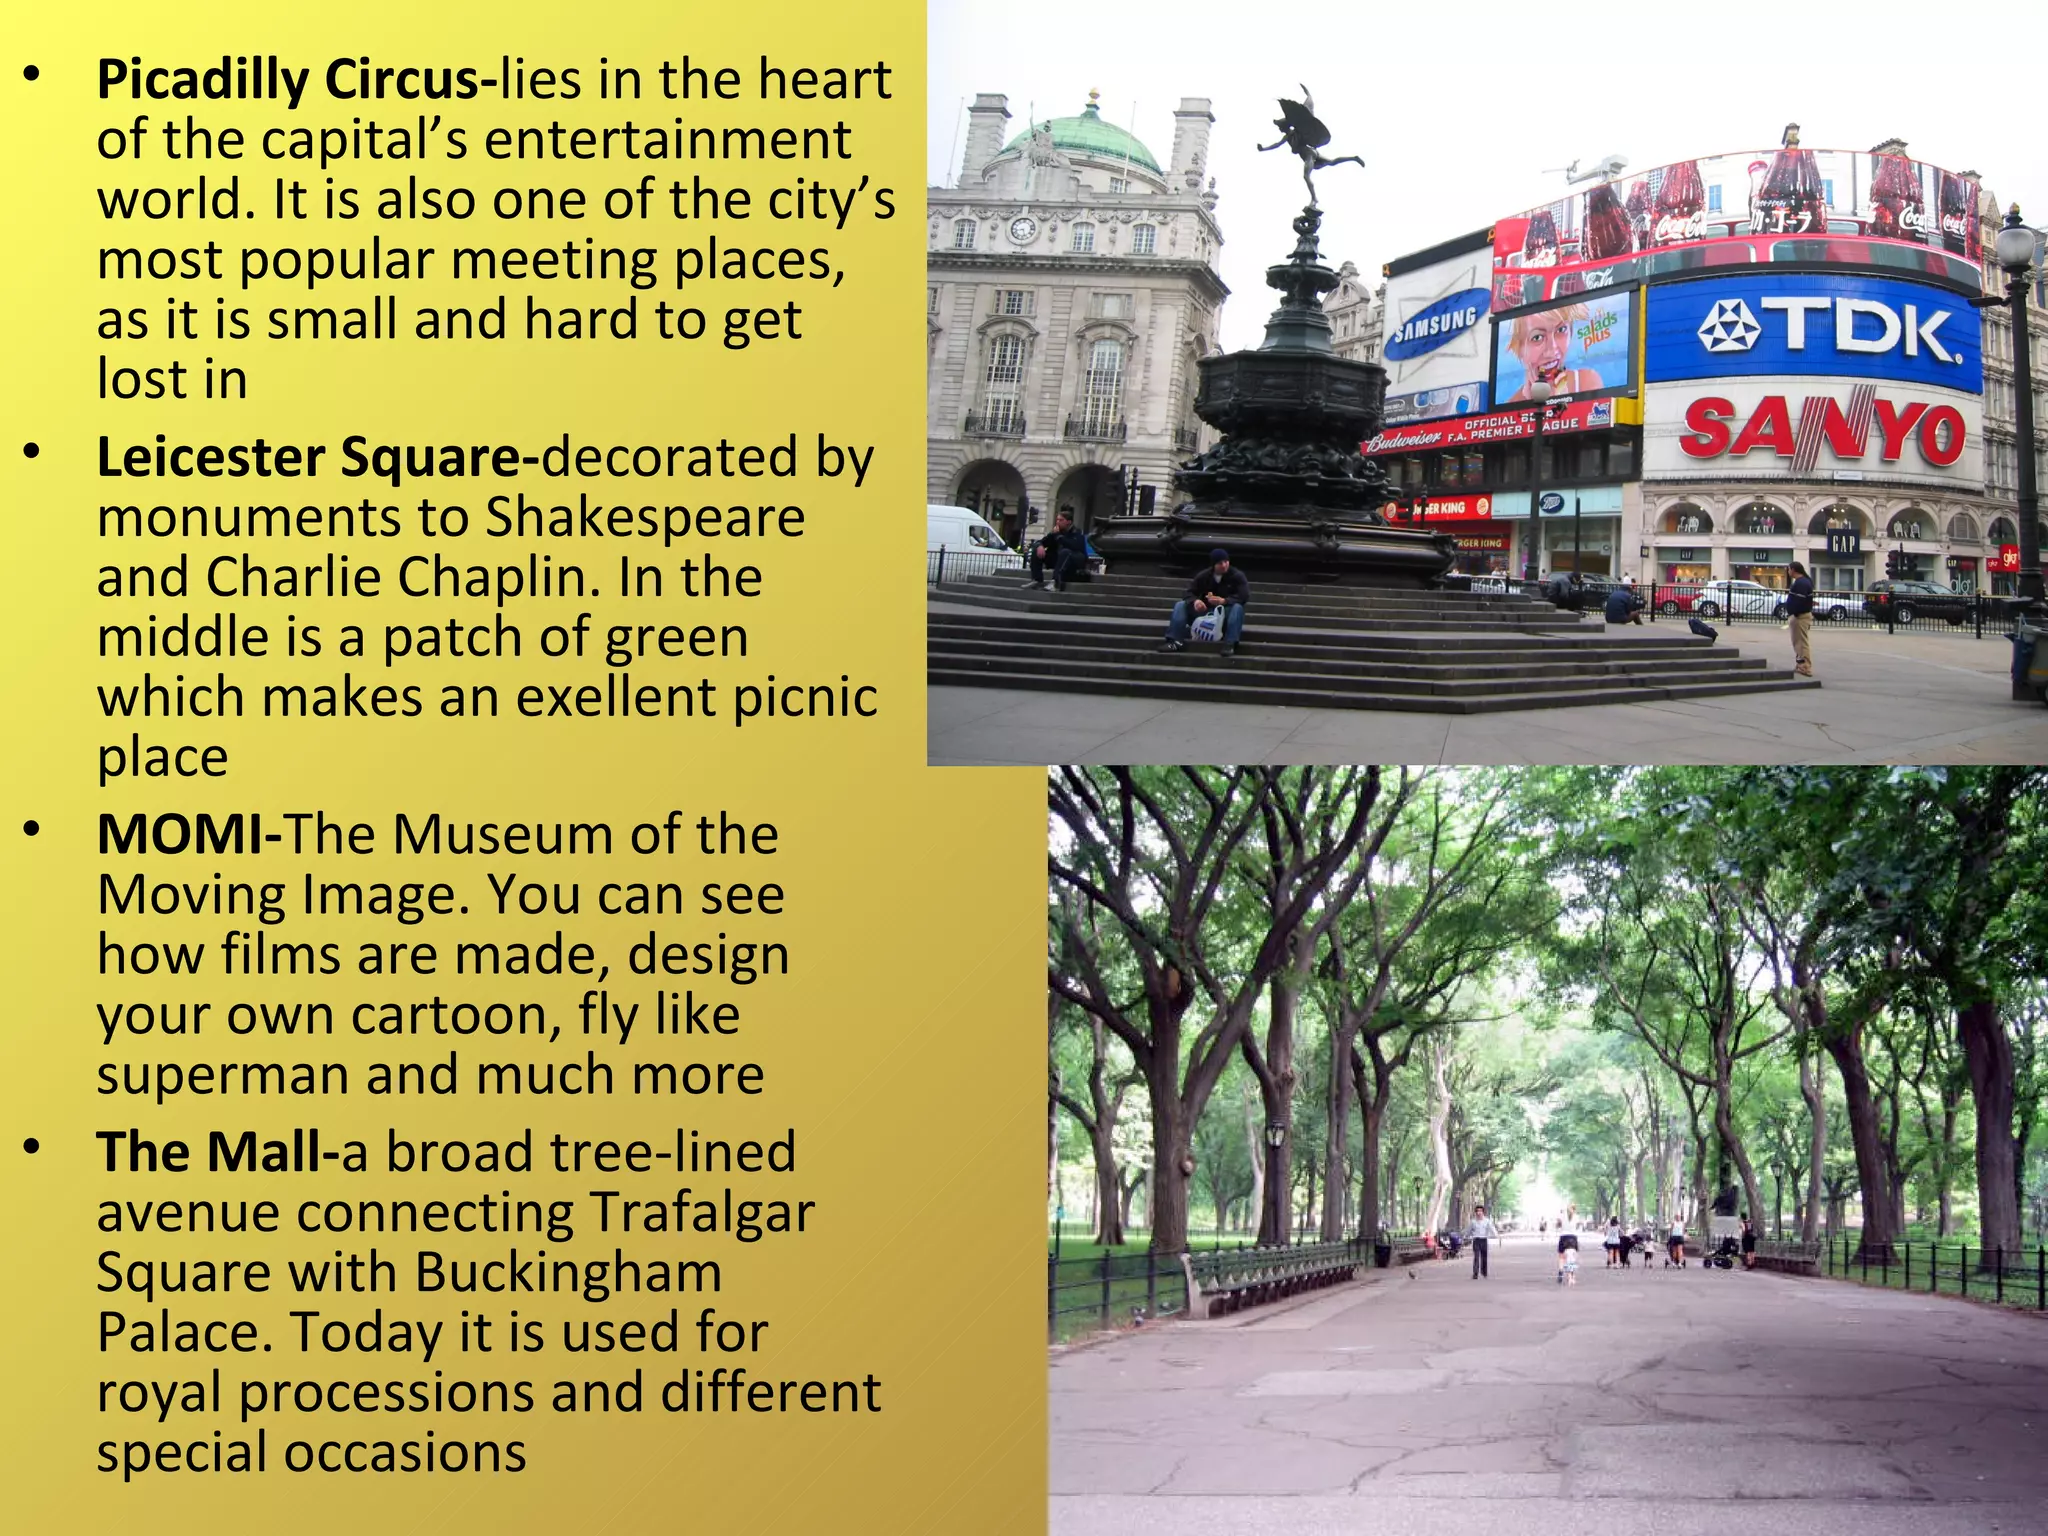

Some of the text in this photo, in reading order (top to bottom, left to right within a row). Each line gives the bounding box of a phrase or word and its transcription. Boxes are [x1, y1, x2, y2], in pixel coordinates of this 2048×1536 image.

[1395, 306, 1476, 343] SAMSUNG
[1577, 311, 1618, 340] salads
[1761, 296, 1954, 363] TDK
[1584, 324, 1611, 352] plus
[1448, 433, 1467, 443] F.A.
[1471, 425, 1522, 440] PREMIER
[1528, 417, 1579, 434] LAGUE
[1464, 415, 1516, 430] OFFICIAL
[1679, 384, 1967, 471] SANYO
[1365, 430, 1442, 453] Budweiser
[1441, 501, 1466, 515] KING
[1481, 538, 1502, 548] KING
[1832, 535, 1856, 553] GAP
